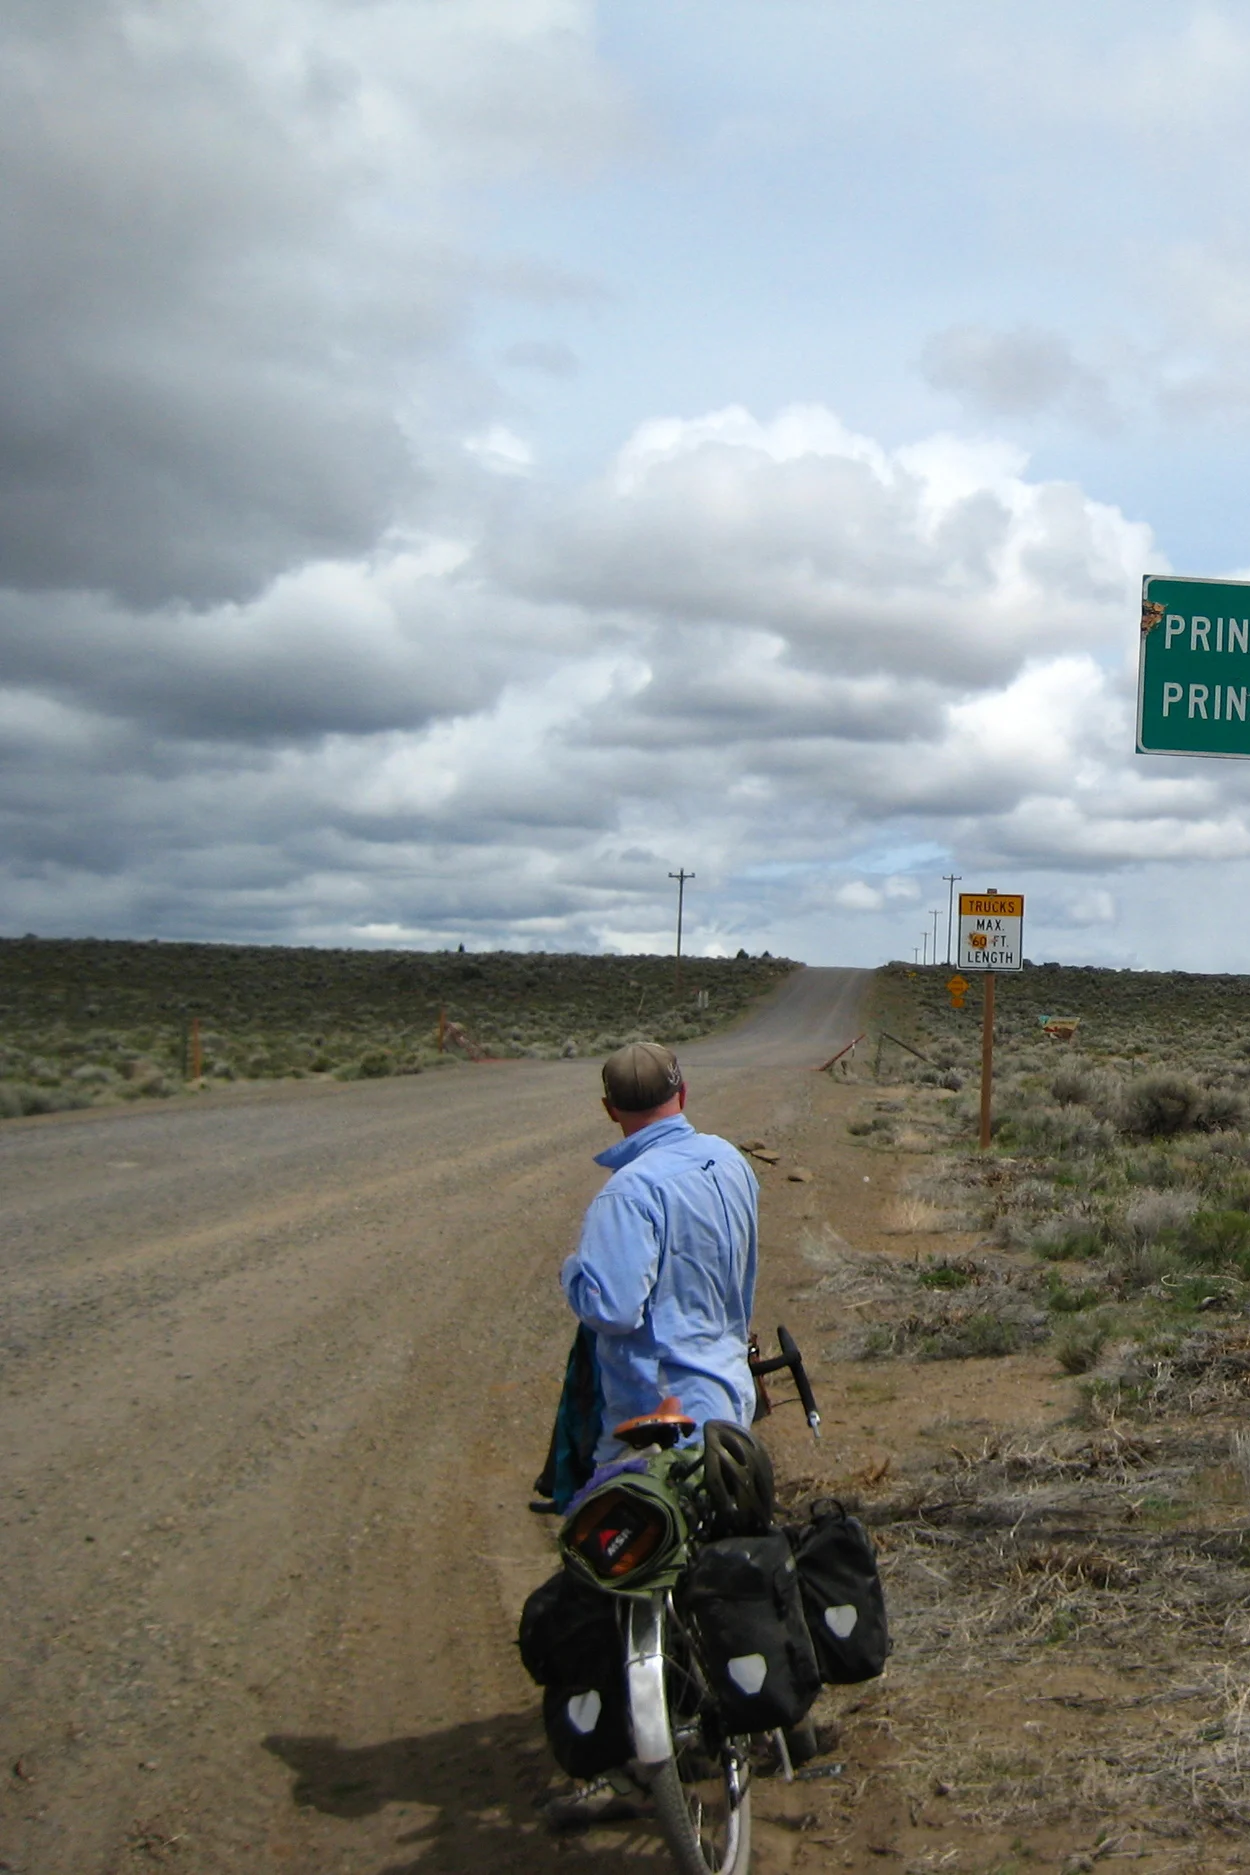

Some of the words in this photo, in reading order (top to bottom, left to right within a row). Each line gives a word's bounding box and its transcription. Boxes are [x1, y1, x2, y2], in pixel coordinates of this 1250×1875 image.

[969, 900, 1015, 914] TRUCKS
[976, 918, 1005, 932] MAX.
[993, 935, 1010, 948] FT.
[967, 950, 1013, 964] LENGTH
